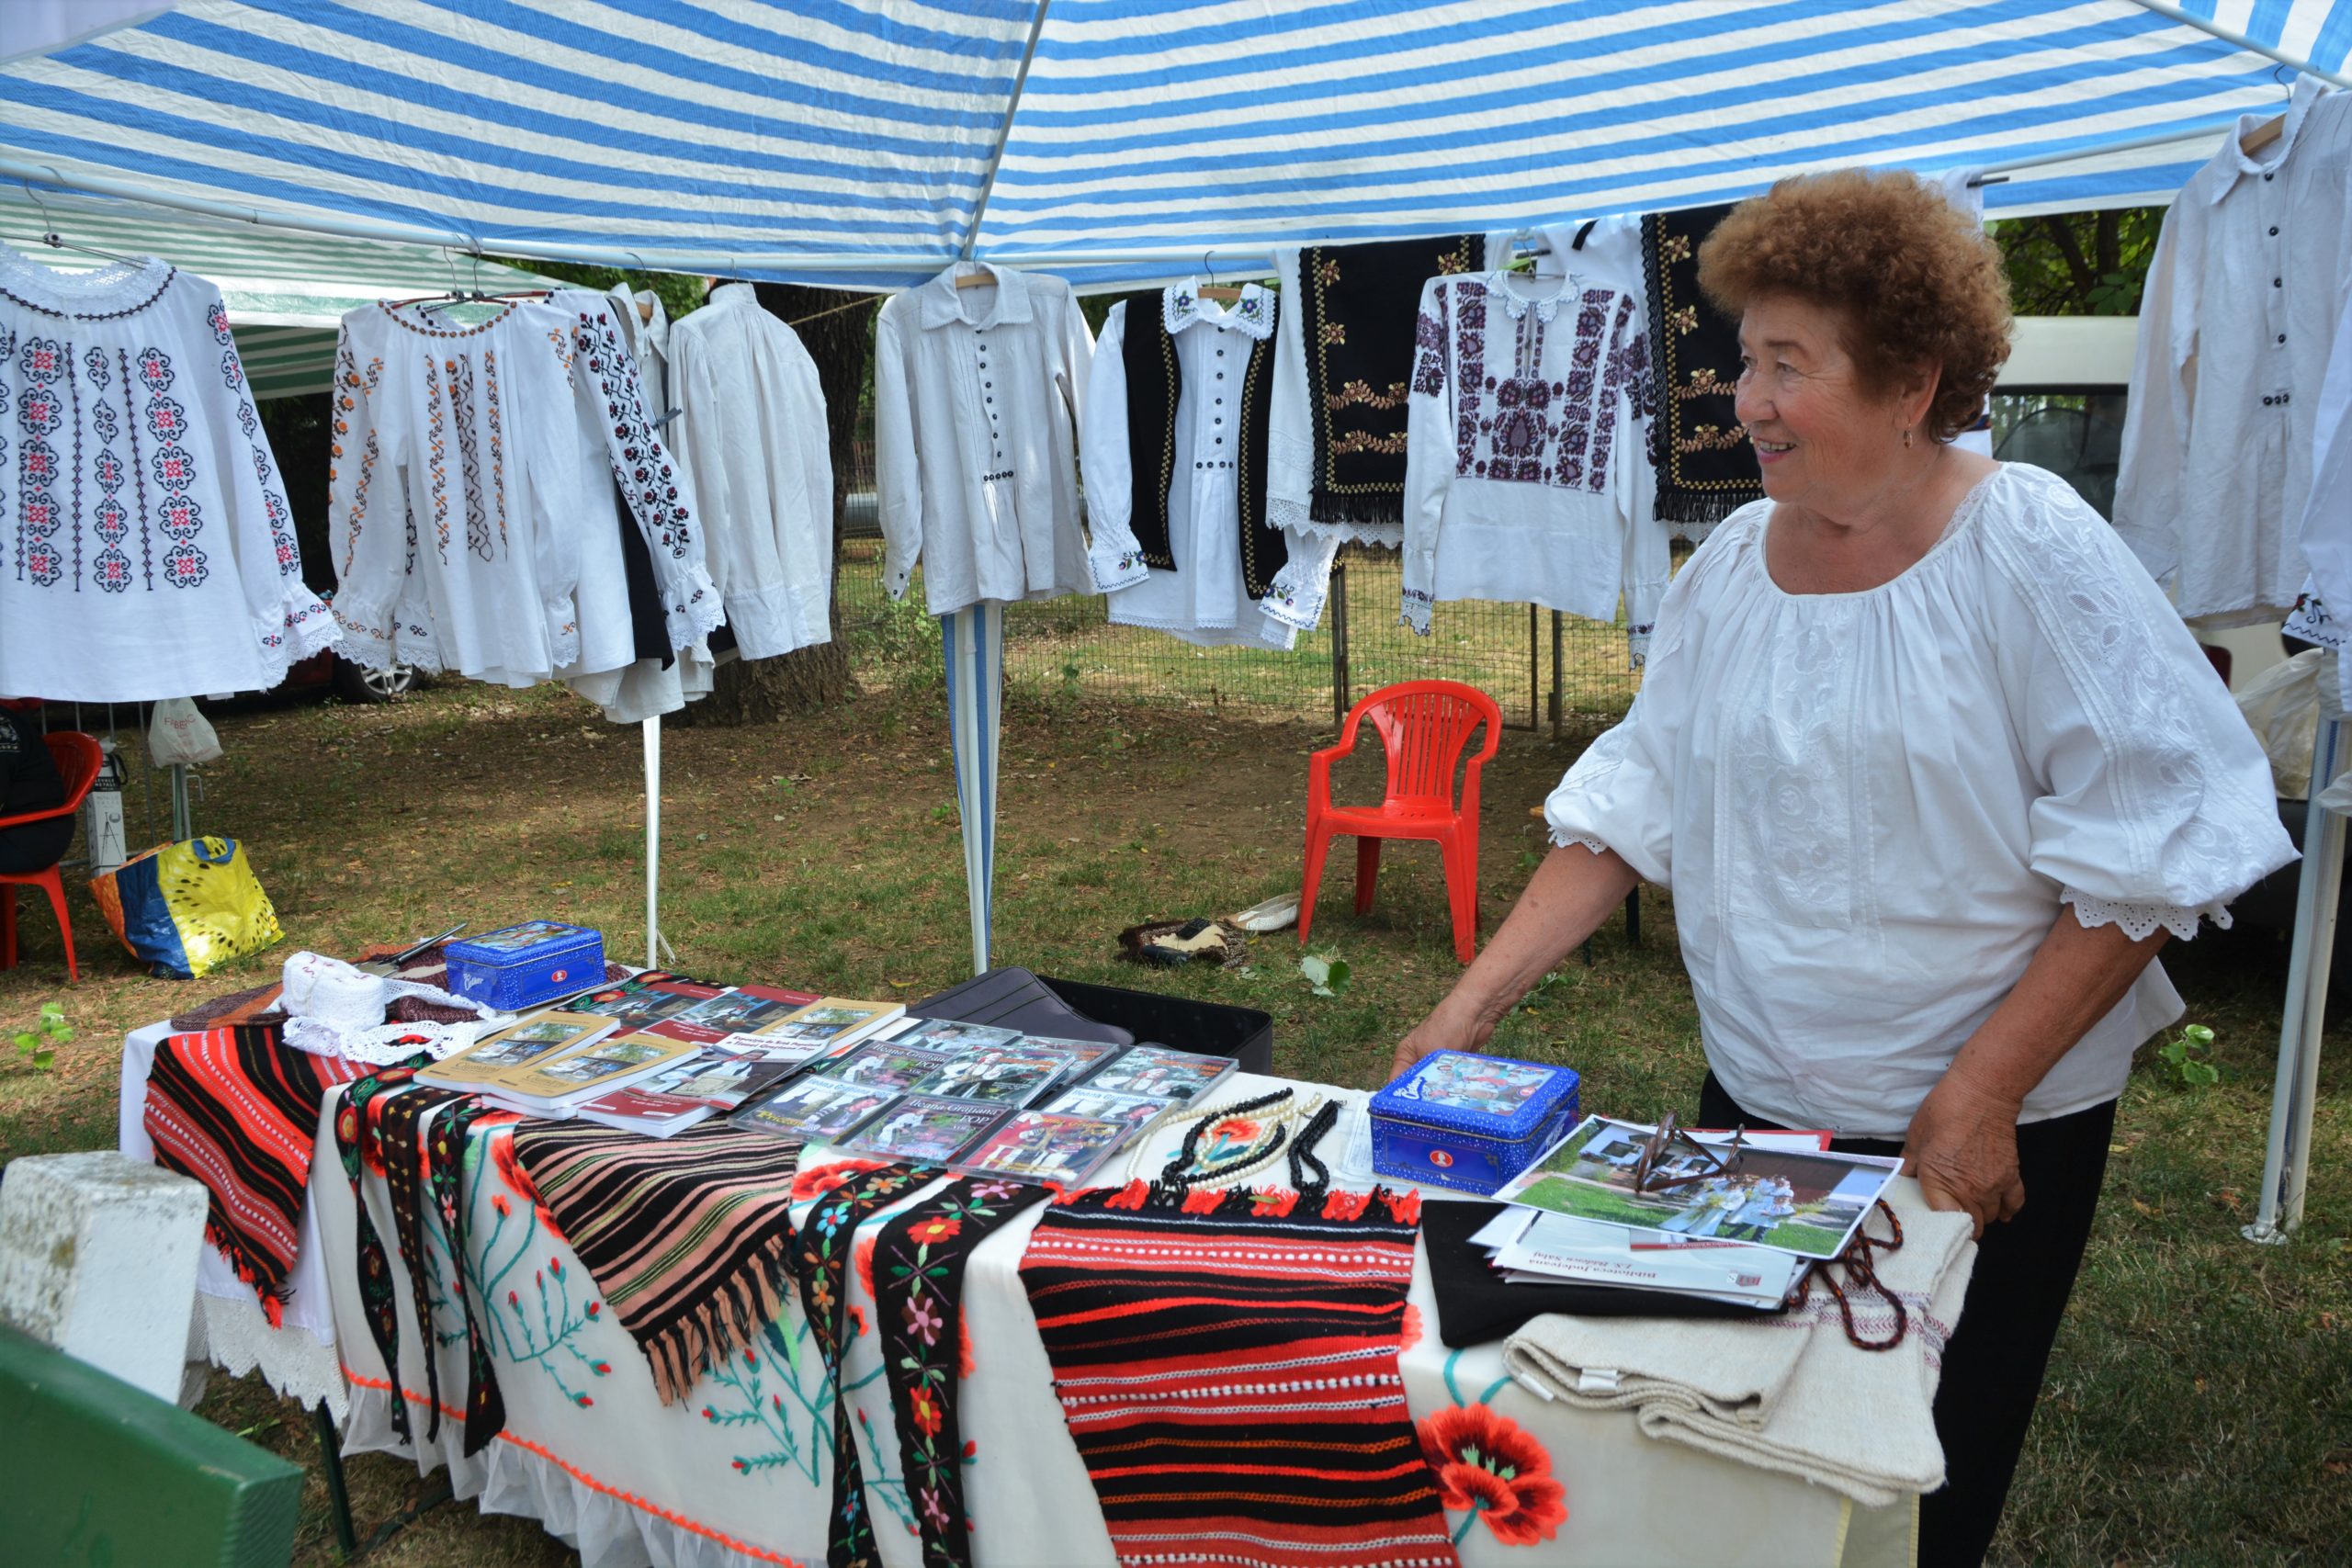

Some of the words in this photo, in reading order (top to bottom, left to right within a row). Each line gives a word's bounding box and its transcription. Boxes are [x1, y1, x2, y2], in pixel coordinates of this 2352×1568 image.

[909, 1099, 944, 1111] Ileana
[959, 1114, 990, 1124] POP
[1594, 1265, 1657, 1280] Biblioteca
